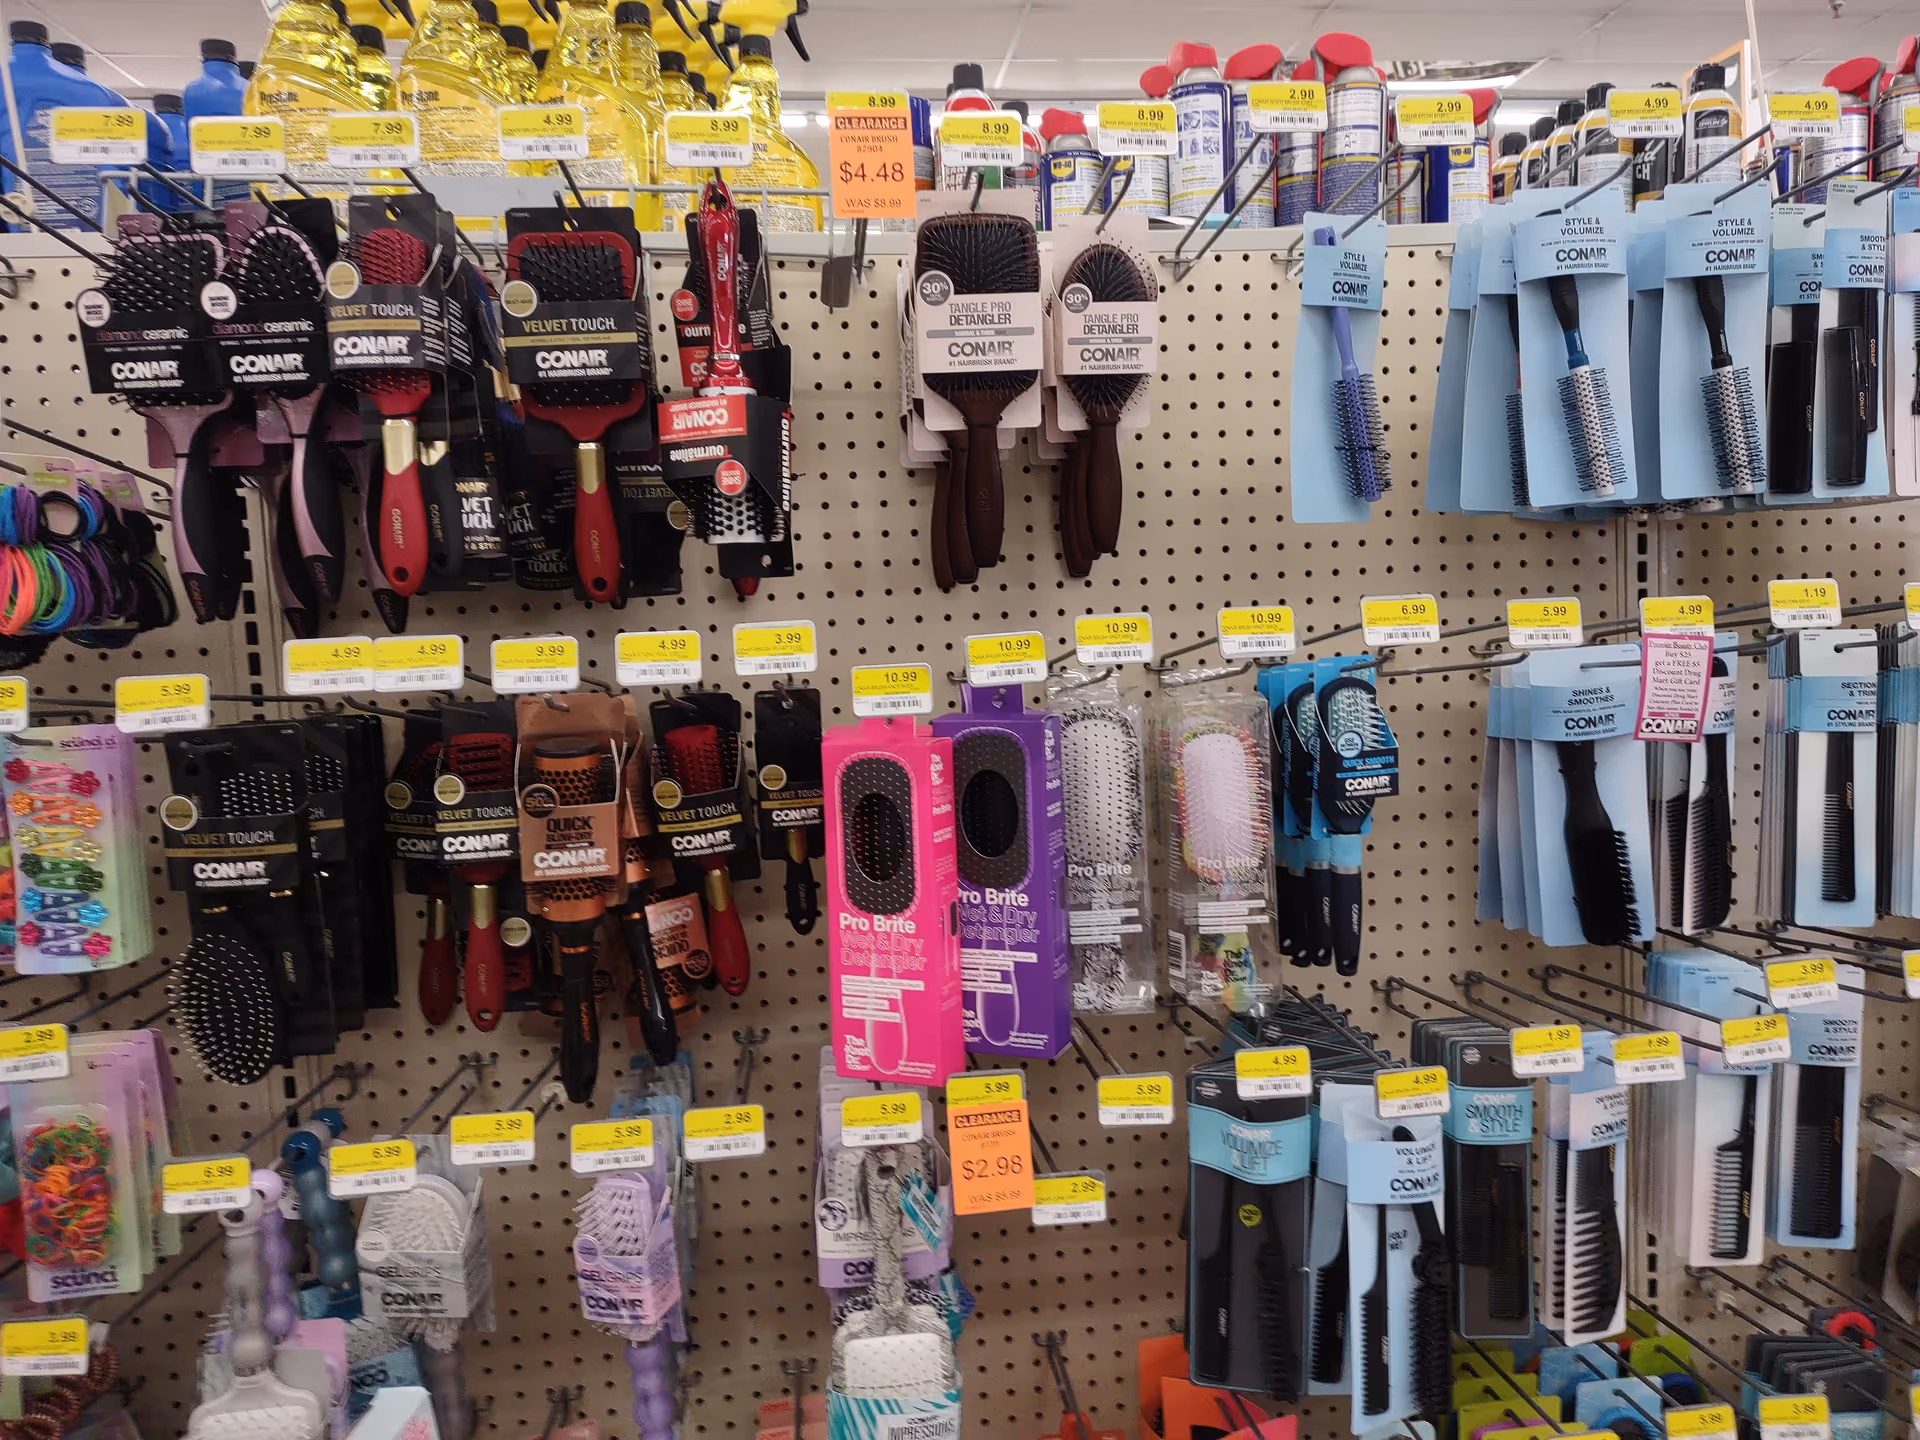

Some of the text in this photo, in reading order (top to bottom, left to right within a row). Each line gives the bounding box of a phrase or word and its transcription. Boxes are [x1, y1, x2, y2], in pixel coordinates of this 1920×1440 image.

[1289, 88, 1315, 101] 2.98
[868, 96, 896, 108] 8.99
[1436, 101, 1462, 112] 2.99
[1644, 98, 1669, 109] 4.99
[1804, 101, 1829, 111] 4.99
[103, 114, 133, 128] 7.99
[543, 114, 573, 128] 4.99
[1137, 108, 1164, 121] 8.99
[372, 121, 402, 134] 7.99
[710, 120, 739, 133] 8.99
[836, 117, 906, 130] CLEARANCE
[982, 123, 1009, 135] 8.99
[240, 126, 271, 139] 7.99
[840, 161, 904, 184] $4.48
[845, 199, 870, 208] WAS
[1565, 217, 1590, 226] STYLE
[1718, 218, 1752, 227] STYLE &
[1561, 227, 1604, 236] VOLUMIZE
[1713, 228, 1754, 237] VOLUMIZE
[1344, 252, 1360, 261] STYLE
[1556, 248, 1606, 262] CONAIR
[1705, 249, 1755, 264] CONAIR
[1340, 261, 1367, 272] VOLUMIZE
[1849, 264, 1884, 276] CONAIR
[922, 281, 948, 295] 30%
[1333, 282, 1368, 295] CONAIR
[1066, 293, 1088, 305] 30%
[330, 304, 416, 318] VELVET TOUCH
[948, 300, 1011, 314] TANGLE PRO
[522, 317, 617, 332] VELVET TOUCH
[949, 312, 1012, 326] DETANGLER
[1083, 313, 1139, 325] TANGLE PRO
[1083, 323, 1139, 336] DETANGLER
[333, 336, 409, 356] CONAIR
[948, 341, 1013, 357] CONAIR
[535, 349, 608, 367] CONAIR
[1080, 347, 1139, 362] CONAIR
[230, 353, 304, 373] CONAIR
[957, 358, 992, 366] HAIRBRUSH
[1088, 363, 1119, 371] HAIRBRUSH
[111, 360, 179, 381] CONAIR
[672, 407, 730, 430] CONAIR
[669, 442, 732, 462] Tourmaline
[781, 410, 791, 512] Tourmaline
[1802, 587, 1827, 598] 1.19
[1402, 605, 1426, 615] 6.99
[1542, 606, 1567, 616] 5.99
[1678, 605, 1703, 615] 4.99
[1249, 612, 1282, 624] 10.99
[1104, 622, 1138, 633] 10.99
[417, 643, 446, 656] 4.99
[535, 645, 565, 656] 9.99
[658, 638, 687, 650] 4.99
[997, 639, 1031, 651] 10.99
[332, 647, 360, 659] 4.99
[884, 671, 917, 683] 10.99
[1653, 668, 1683, 676] Discount
[160, 684, 191, 696] 5.99
[1841, 681, 1877, 689] SECTION
[1572, 687, 1602, 697] SHINES
[1567, 694, 1614, 706] SMOOTHES
[1827, 709, 1875, 720] CONAIR
[1564, 714, 1614, 730] CONAIR
[1641, 718, 1697, 734] CONAIR
[1342, 758, 1363, 767] QUICK
[1345, 776, 1389, 790] CONAIR
[436, 805, 514, 821] VELVET TOUCH
[698, 803, 738, 818] TOUCH
[772, 808, 820, 820] CONAIR
[545, 817, 592, 832] QUICK
[228, 831, 275, 844] TOUCH
[442, 833, 511, 853] CONAIR
[671, 830, 732, 850] CONAIR
[533, 848, 607, 868] CONAIR
[1197, 855, 1260, 869] Pro Brite
[193, 862, 268, 878] CONAIR
[1068, 862, 1133, 877] Pro Brite
[983, 888, 1030, 907] Brite
[838, 913, 917, 934] Pro Brite
[1754, 1019, 1778, 1032] 2.99
[1808, 1044, 1856, 1056] CONAIR
[1272, 1055, 1297, 1067] 4.99
[984, 1081, 1010, 1093] 5.99
[1136, 1083, 1162, 1095] 5.99
[880, 1103, 906, 1116] 5.99
[1465, 1104, 1523, 1120] SMOOTH
[955, 1111, 1022, 1128] CLEARANCE
[1480, 1119, 1521, 1134] STYLE
[1220, 1132, 1284, 1157] VOLUMIZE
[961, 1154, 1024, 1182] $2.98
[1240, 1155, 1268, 1171] LIFT
[1390, 1173, 1440, 1191] CONAIR
[381, 1292, 444, 1307] CONAIR
[585, 1296, 643, 1311] CONAIR
